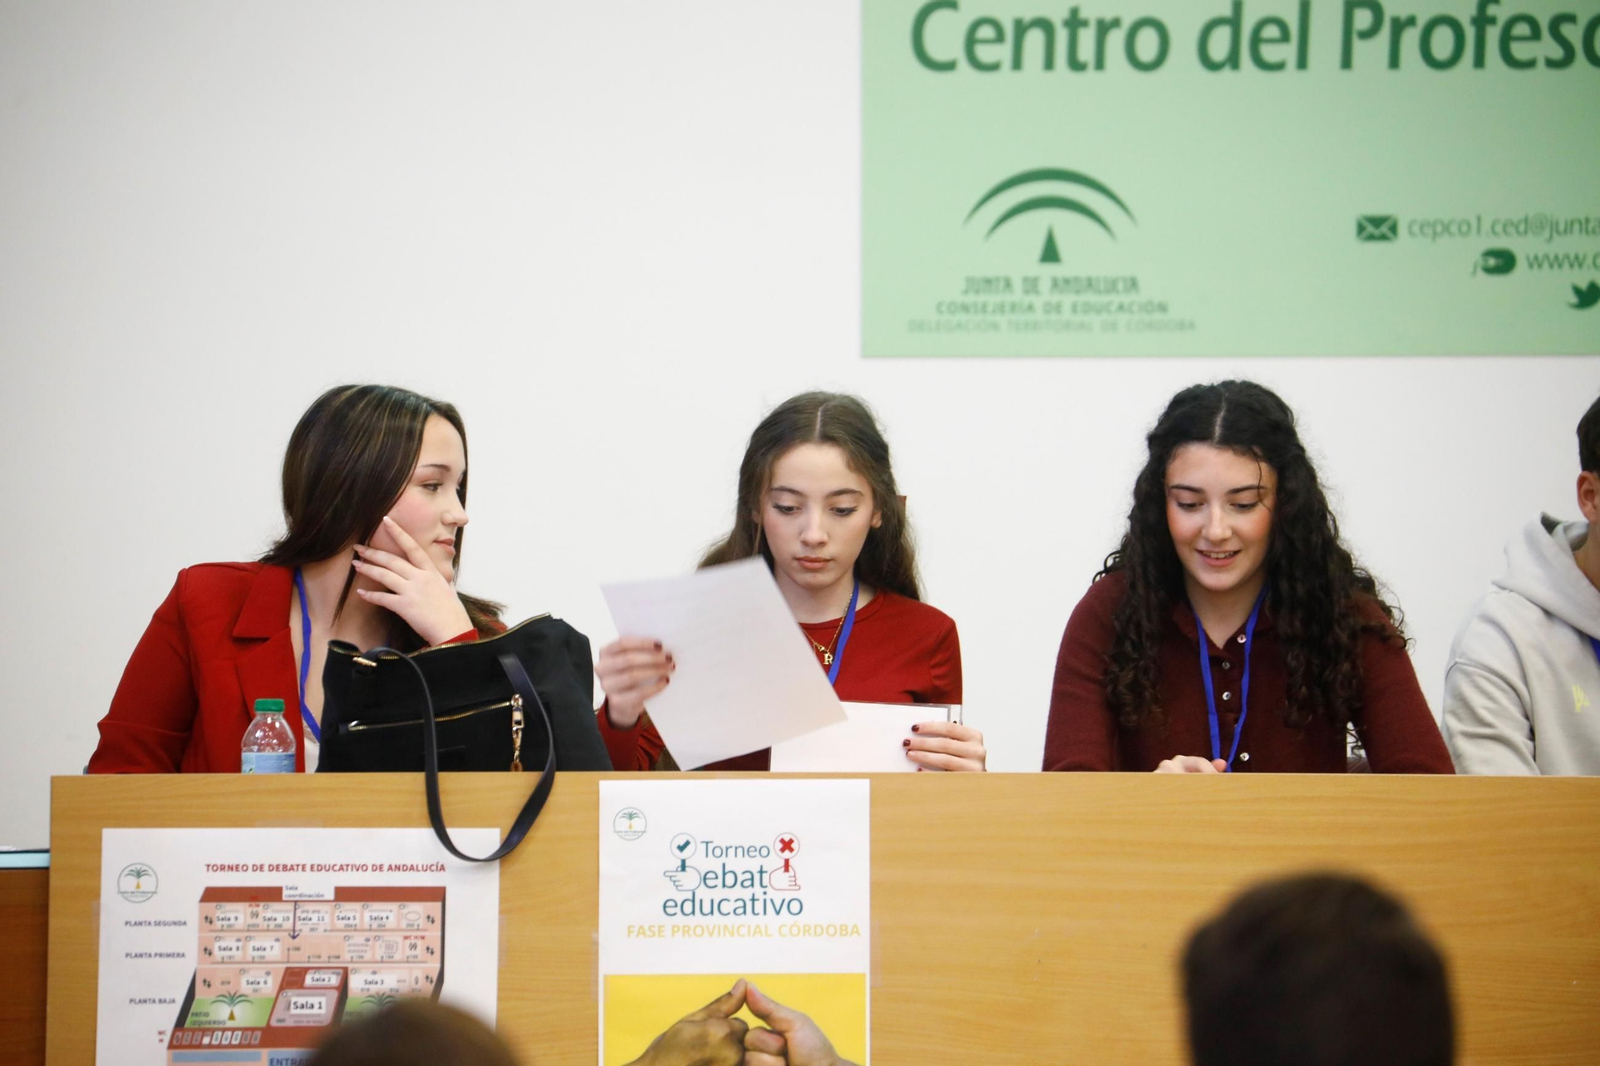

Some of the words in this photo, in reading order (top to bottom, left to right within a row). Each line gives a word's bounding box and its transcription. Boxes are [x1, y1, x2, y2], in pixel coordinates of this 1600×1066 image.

[911, 0, 1170, 72] Centro
[1197, 0, 1310, 72] del
[961, 275, 1014, 296] JUNTA
[1022, 275, 1041, 296] DE
[1043, 302, 1063, 315] DE
[700, 840, 771, 859] Torneo
[205, 864, 248, 872] TORNEO
[252, 864, 264, 872] DE
[268, 864, 305, 872] DEBATE
[310, 863, 368, 872] EDUCATIVO
[372, 863, 384, 872] DE
[387, 861, 446, 872] ANDALUCÍA
[662, 890, 804, 917] educativo
[124, 919, 152, 927] PLANTA
[153, 919, 188, 927] SEGUNDA
[627, 924, 666, 938] FASE
[671, 923, 773, 938] PROVINCIAL
[778, 920, 861, 938] CÓRDOBA
[125, 951, 152, 959] PLANTA
[153, 951, 186, 959] PRIMERA
[311, 975, 325, 983] Sala
[363, 978, 378, 986] Sala
[128, 997, 156, 1005] PLANTA
[292, 1000, 315, 1010] Sala
[317, 1001, 323, 1010] 1
